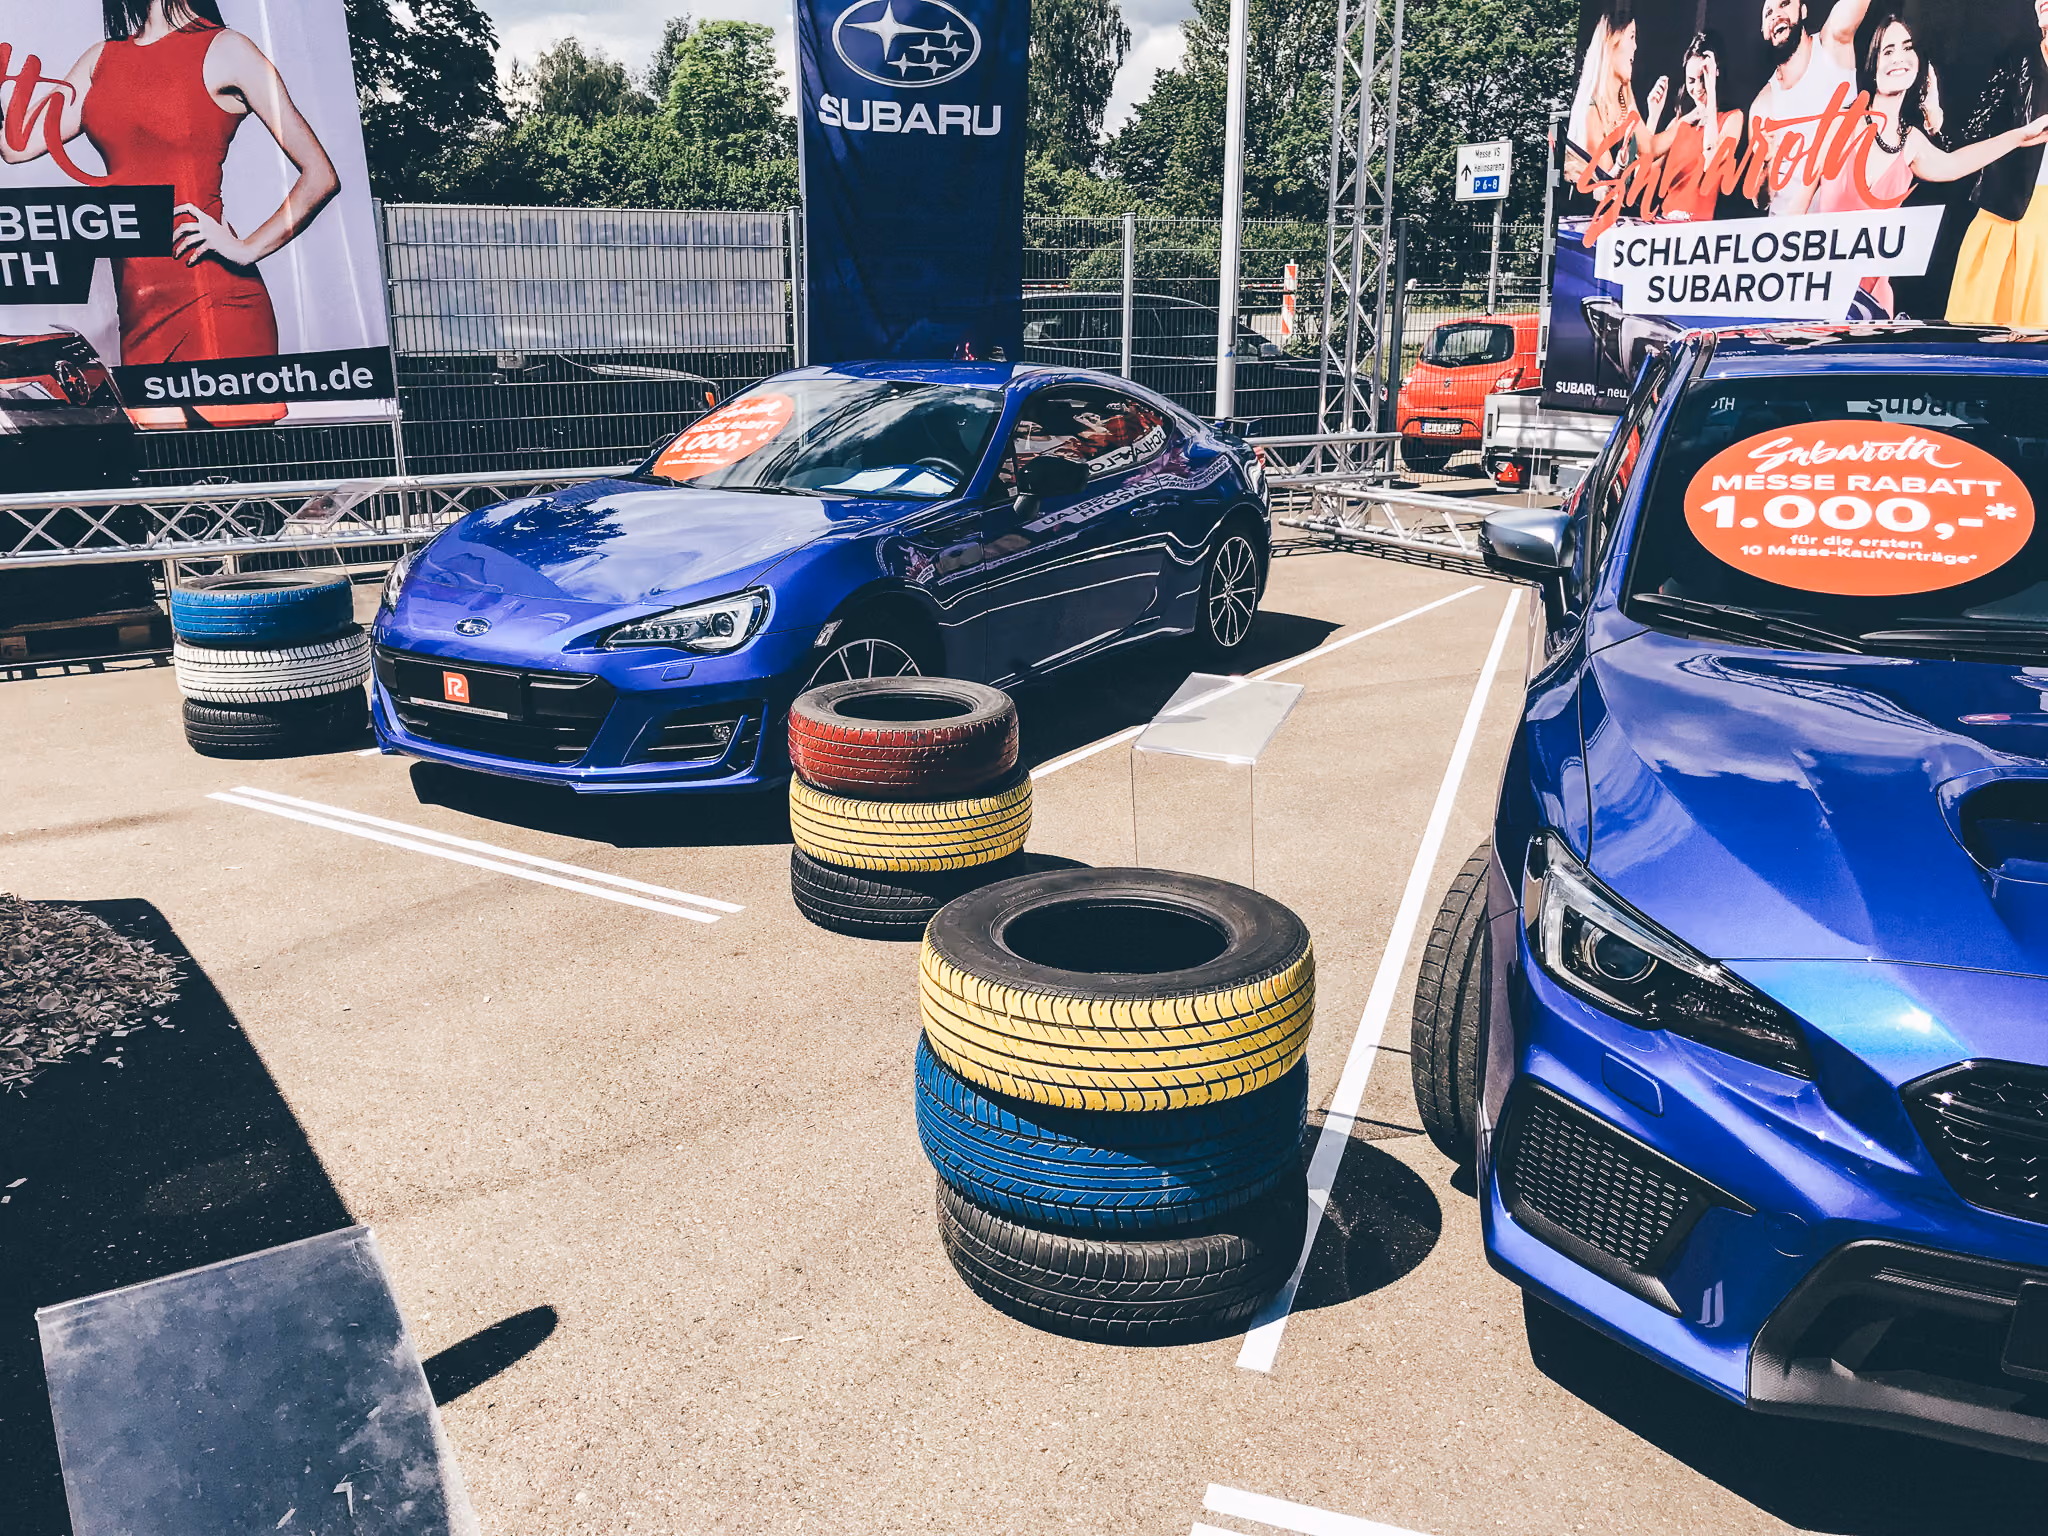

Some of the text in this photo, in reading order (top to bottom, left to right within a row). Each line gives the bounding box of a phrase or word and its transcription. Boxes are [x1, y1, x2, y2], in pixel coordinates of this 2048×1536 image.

[818, 93, 1001, 136] SUBARU
[0, 203, 141, 241] BEIGE
[1613, 225, 1907, 269] SCHLAFLOSBLAU
[1646, 270, 1833, 305] SUBAROTH
[144, 360, 375, 400] subaroth.de
[1747, 435, 1963, 474] Subaroth
[1711, 474, 2003, 498] MESSE RABATT
[1740, 545, 1762, 556] 10
[1790, 534, 1924, 550] für die ersten
